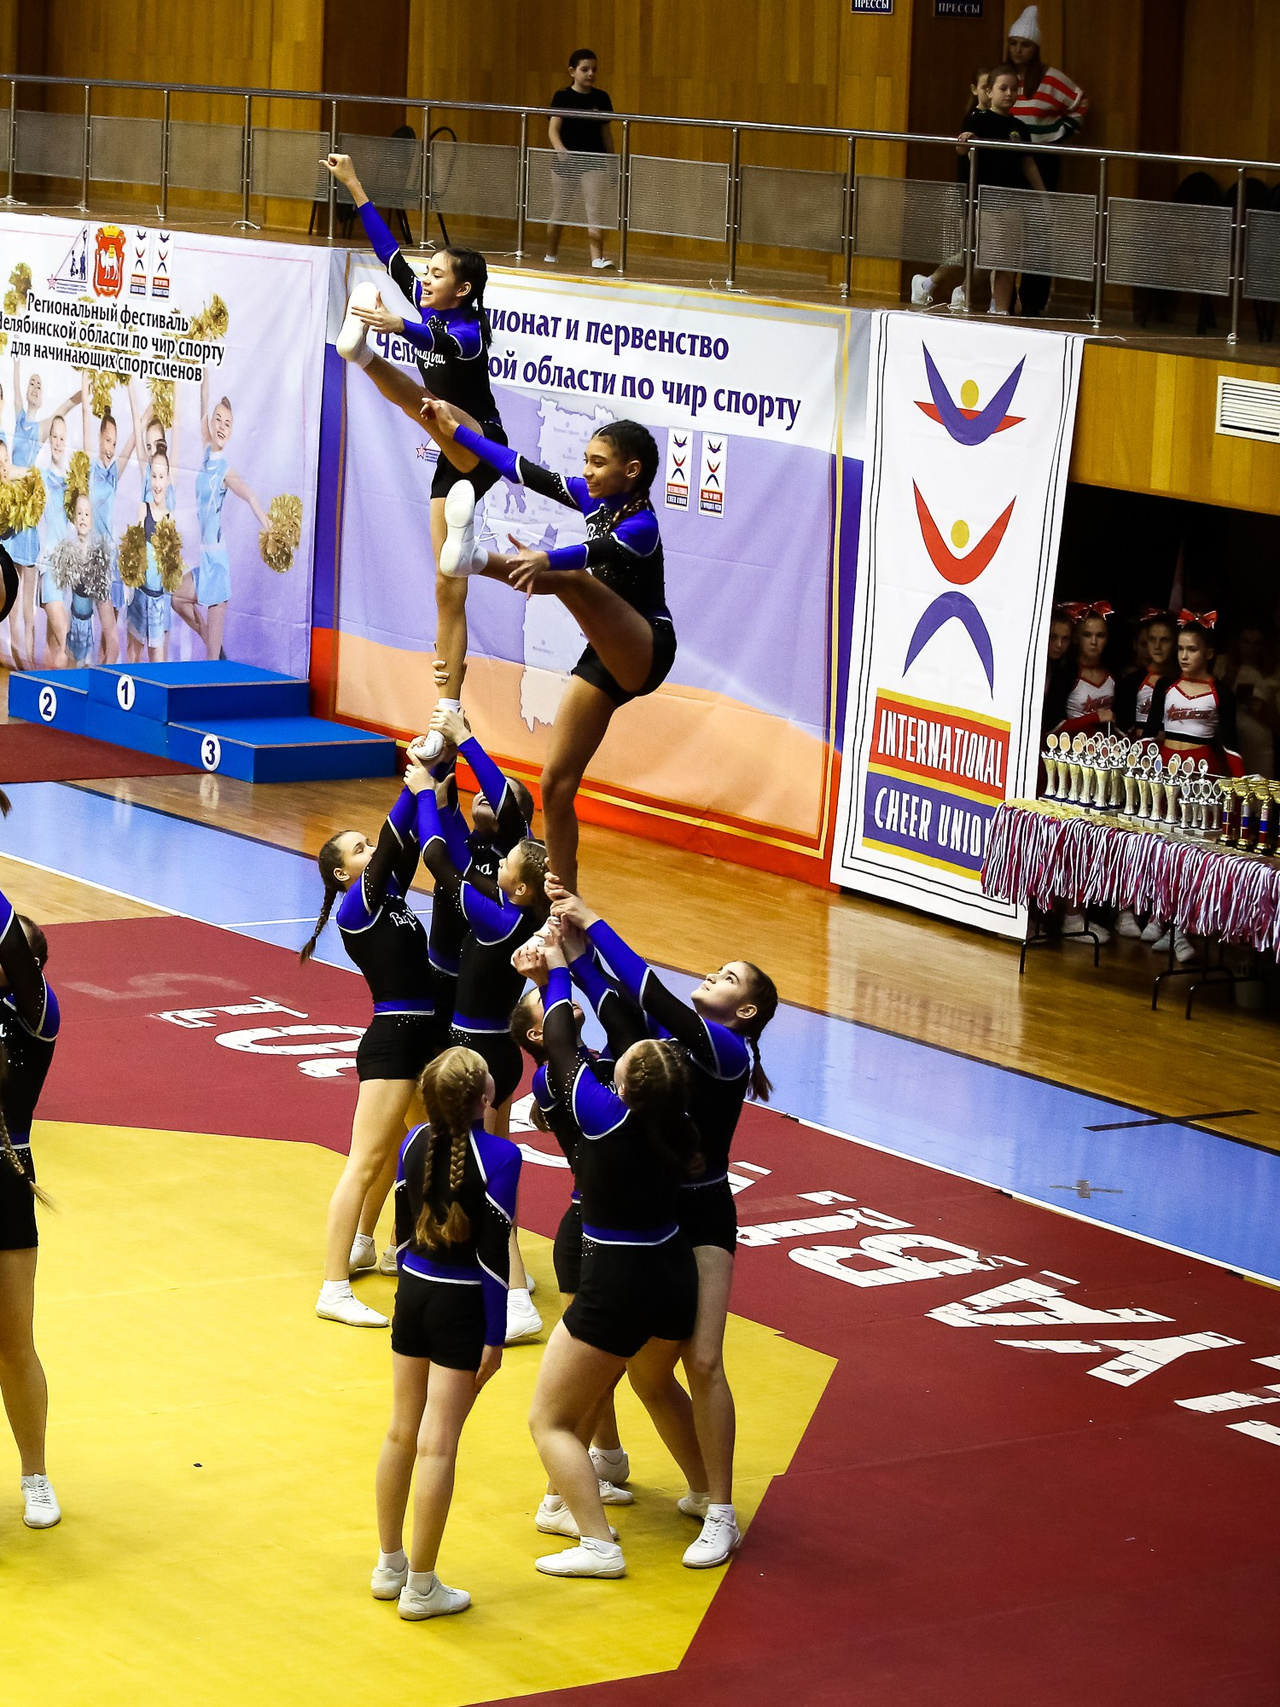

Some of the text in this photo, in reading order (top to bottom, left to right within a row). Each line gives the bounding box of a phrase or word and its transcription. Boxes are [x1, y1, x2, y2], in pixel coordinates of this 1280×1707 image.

[938, 2, 981, 14] ПРЕССЫ
[27, 292, 189, 332] Региональный фестиваль
[79, 323, 129, 348] области
[132, 334, 149, 350] по
[151, 337, 176, 359] чир
[178, 340, 225, 367] спорту
[565, 318, 580, 341] и
[585, 321, 730, 361] первенство
[10, 340, 203, 382] для начинающих спортсменов
[522, 354, 617, 396] области
[621, 375, 655, 400] по
[661, 380, 708, 417] чир
[713, 387, 802, 431] спорту
[41, 692, 54, 716] 2
[120, 681, 129, 706] 1
[204, 740, 216, 766] 3
[876, 708, 1004, 789] INTERNATIONAL
[874, 786, 933, 842] CHEER
